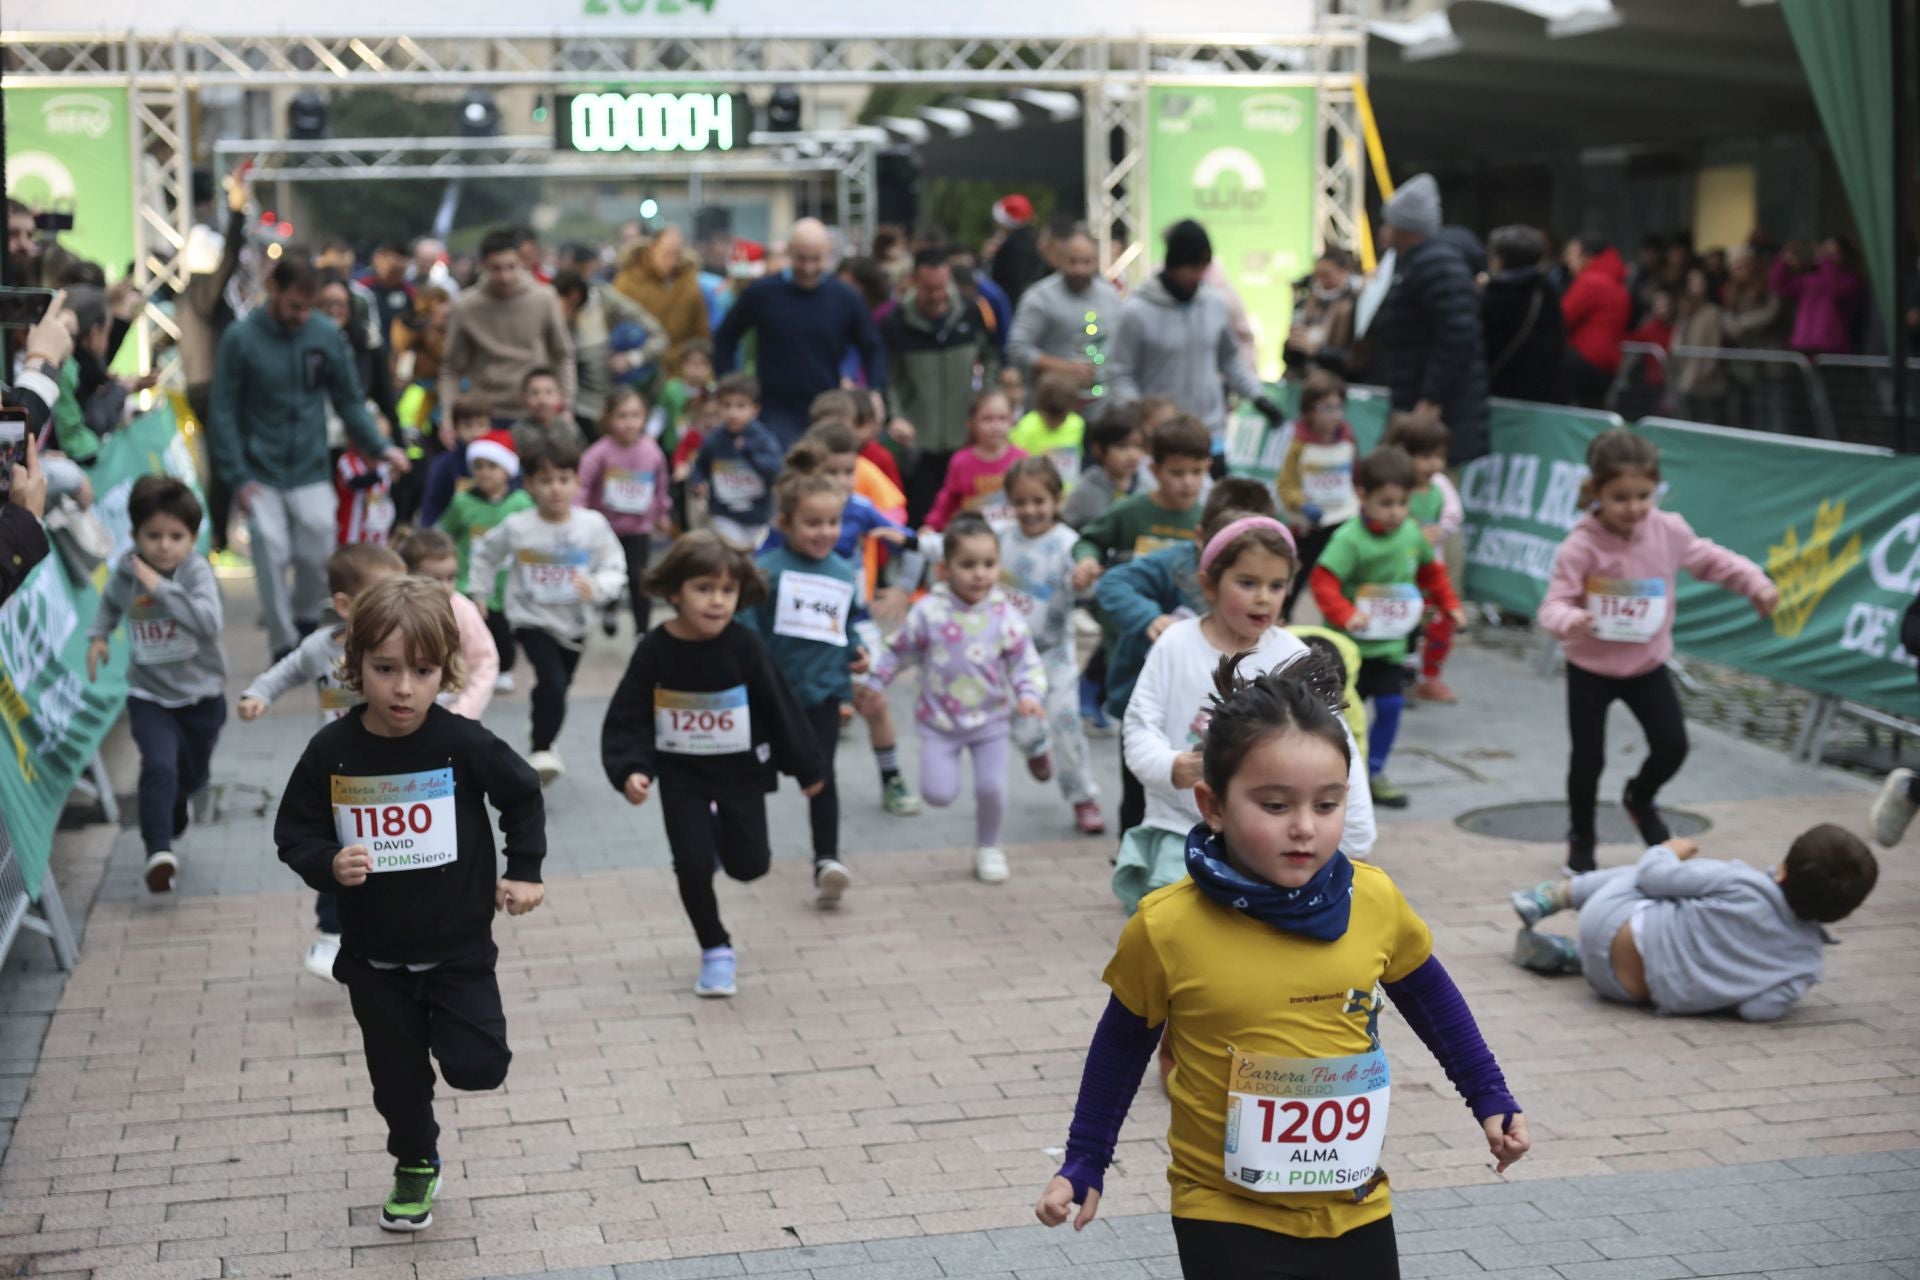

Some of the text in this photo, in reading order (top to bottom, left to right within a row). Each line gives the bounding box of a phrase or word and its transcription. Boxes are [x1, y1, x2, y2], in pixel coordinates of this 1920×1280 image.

[1601, 595, 1649, 620] 1147
[1839, 602, 1899, 658] DE
[671, 710, 734, 732] 1206
[350, 803, 433, 838] 1180
[374, 839, 414, 851] DAVID
[377, 852, 446, 868] PDMSiero
[1238, 1060, 1384, 1083] Carrera Fin de Año
[1236, 1080, 1334, 1096] LA POLA SIERO
[1367, 1076, 1387, 1090] 2024
[1257, 1096, 1371, 1144] 1209
[1290, 1148, 1339, 1163] ALMA
[1288, 1167, 1371, 1185] PDMSiero
